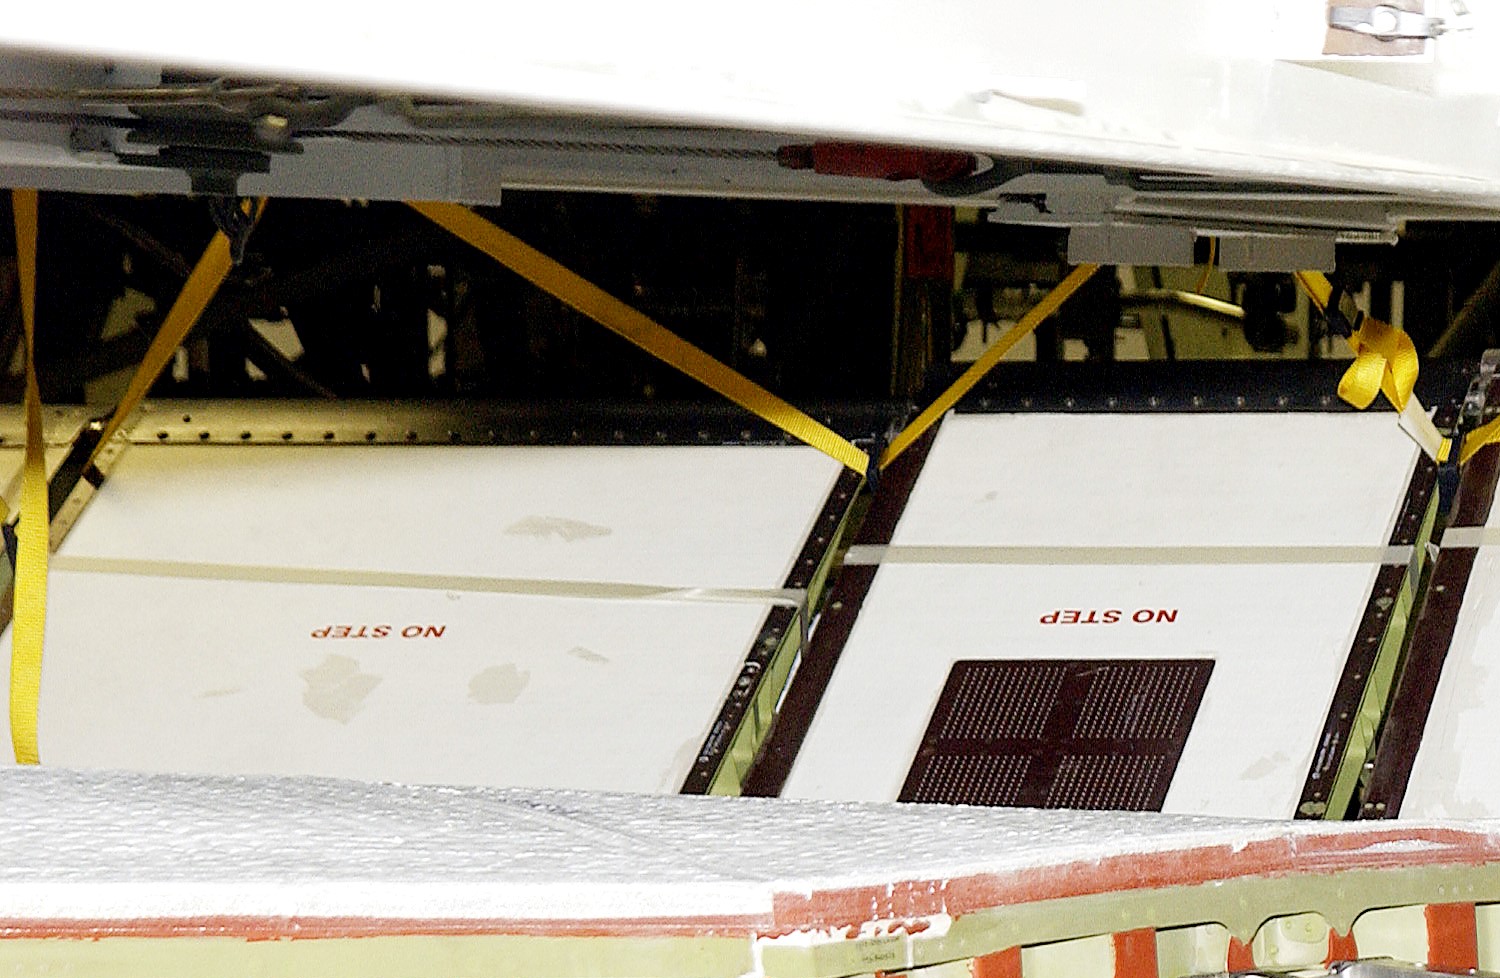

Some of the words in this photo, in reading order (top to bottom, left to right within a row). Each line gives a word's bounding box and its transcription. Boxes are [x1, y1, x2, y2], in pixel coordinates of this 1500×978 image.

[1039, 609, 1121, 624] STEP
[1131, 609, 1178, 624] NO
[310, 625, 392, 638] STEP
[401, 625, 446, 638] NO
